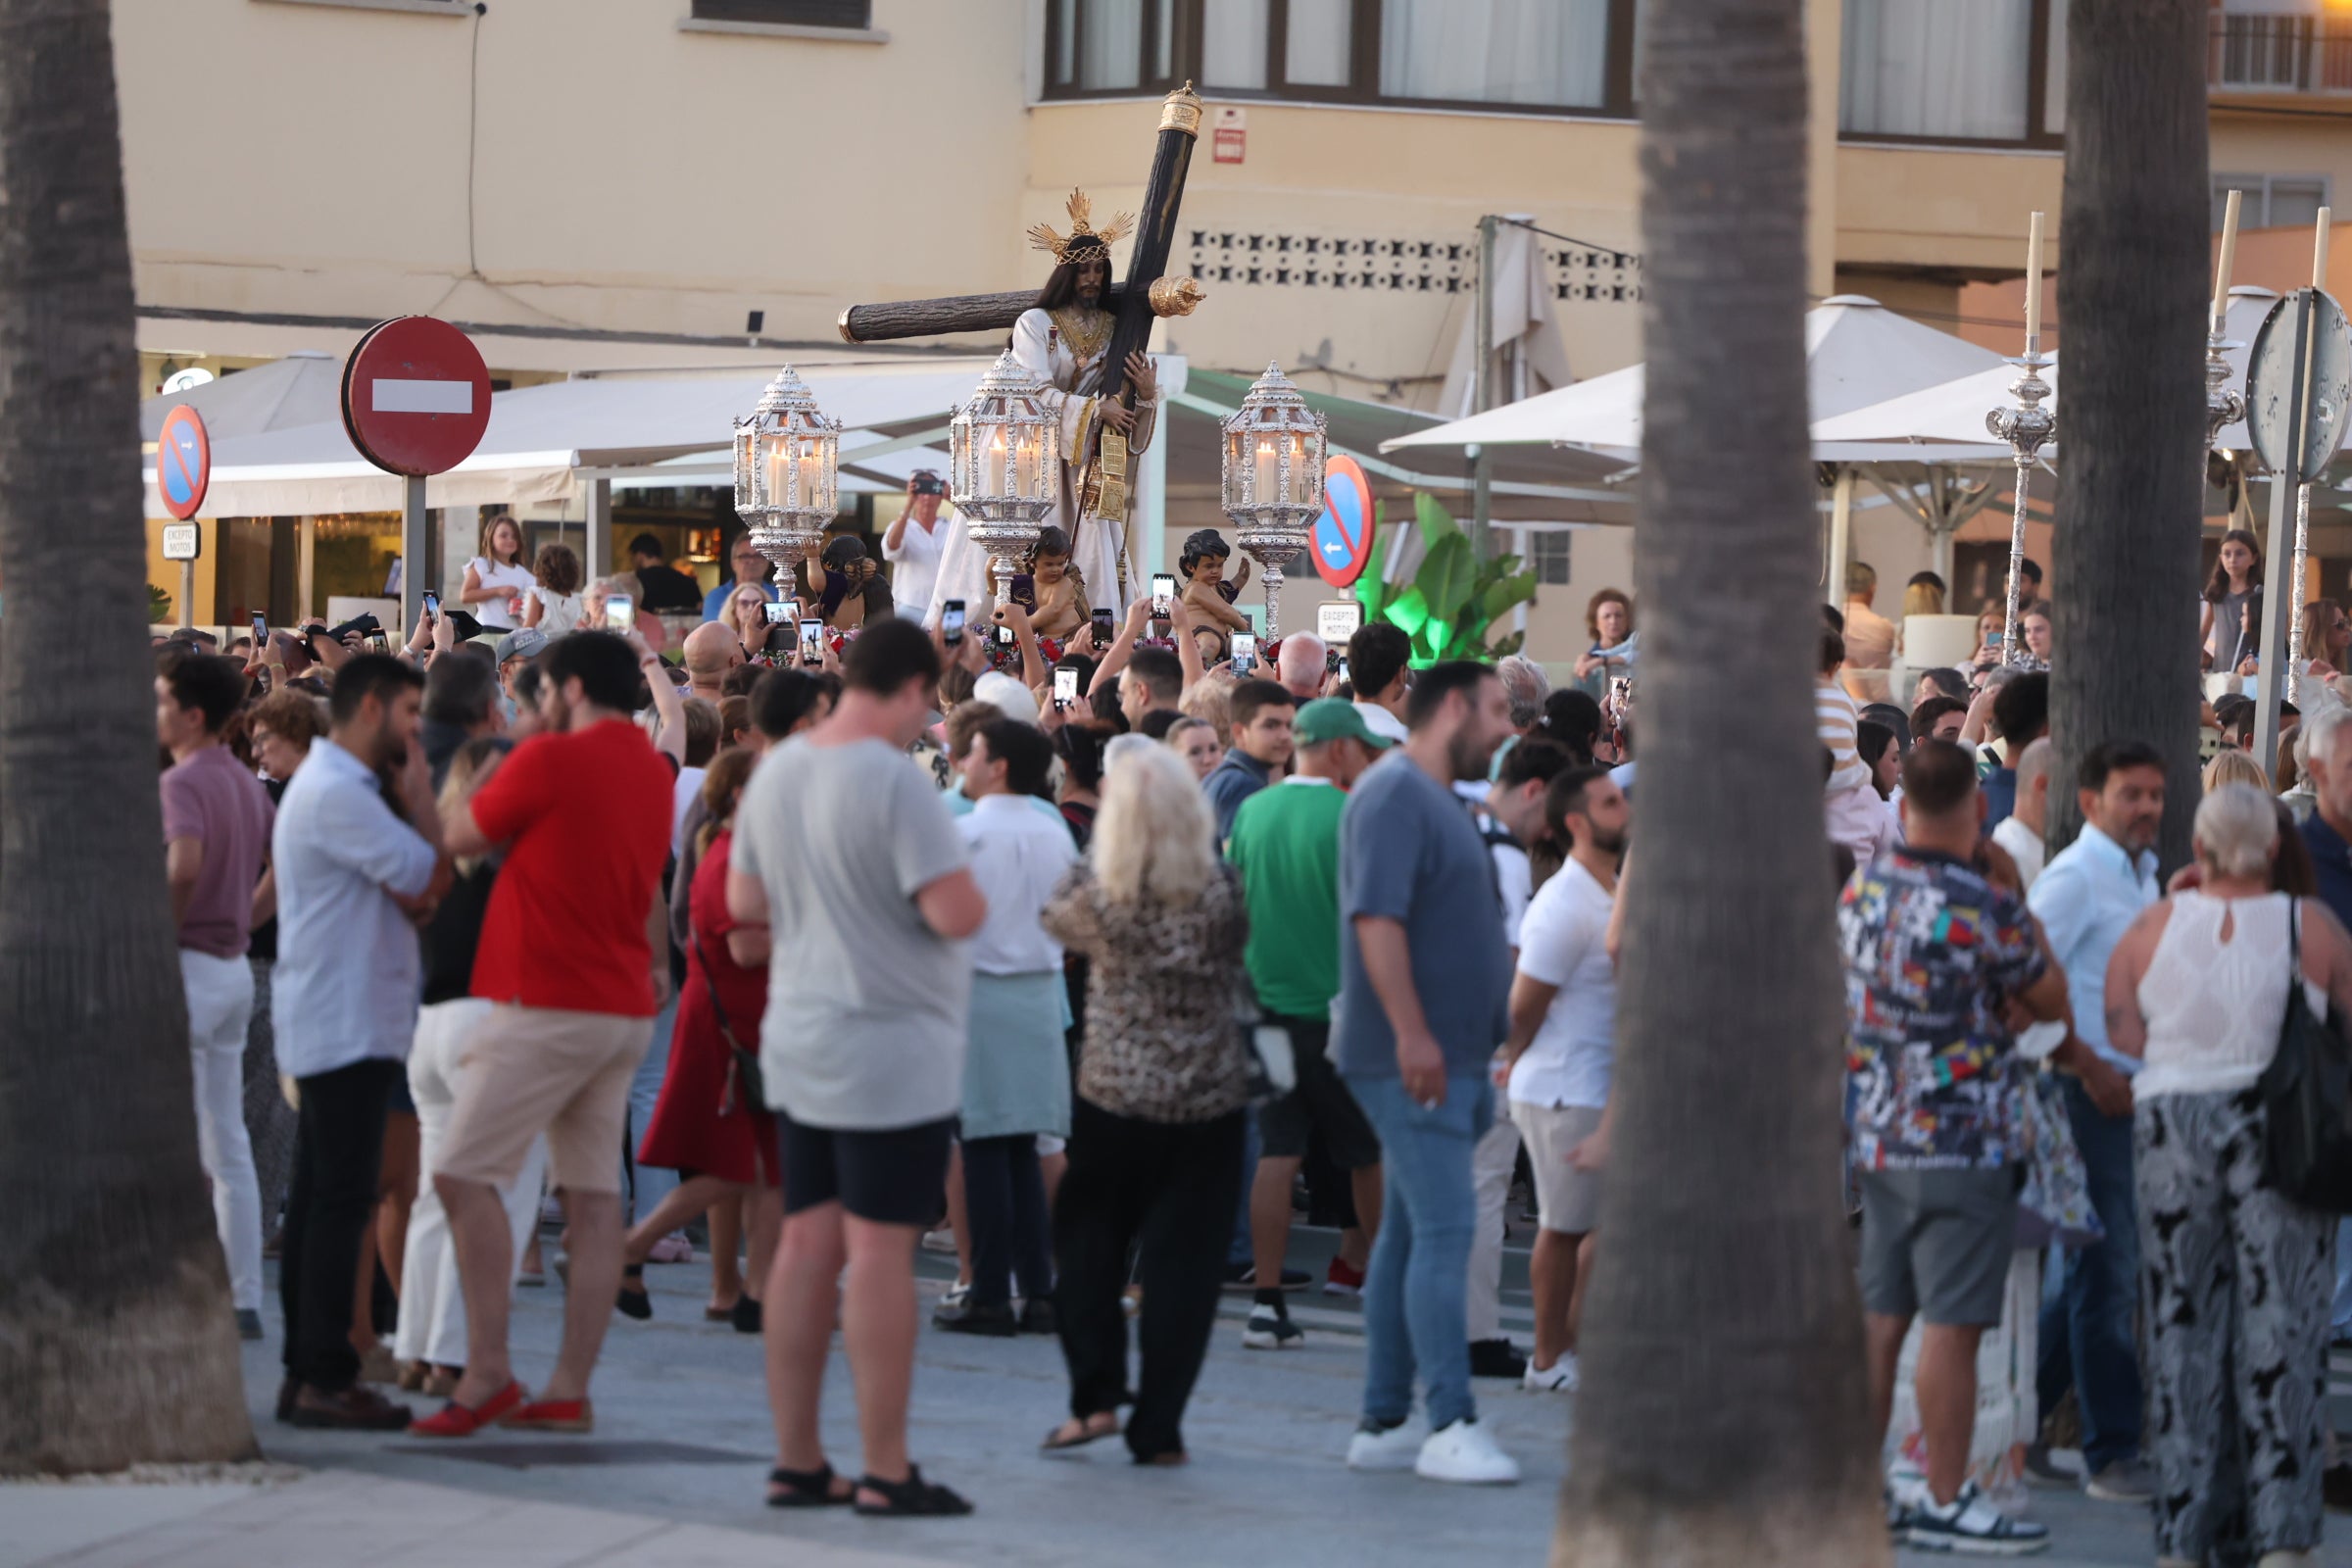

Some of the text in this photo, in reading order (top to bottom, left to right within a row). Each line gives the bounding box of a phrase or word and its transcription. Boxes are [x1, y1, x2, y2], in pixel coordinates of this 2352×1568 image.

[168, 529, 193, 540] EXCEPTO
[170, 542, 191, 553] MOTOS
[1323, 611, 1355, 621] EXCEPTO
